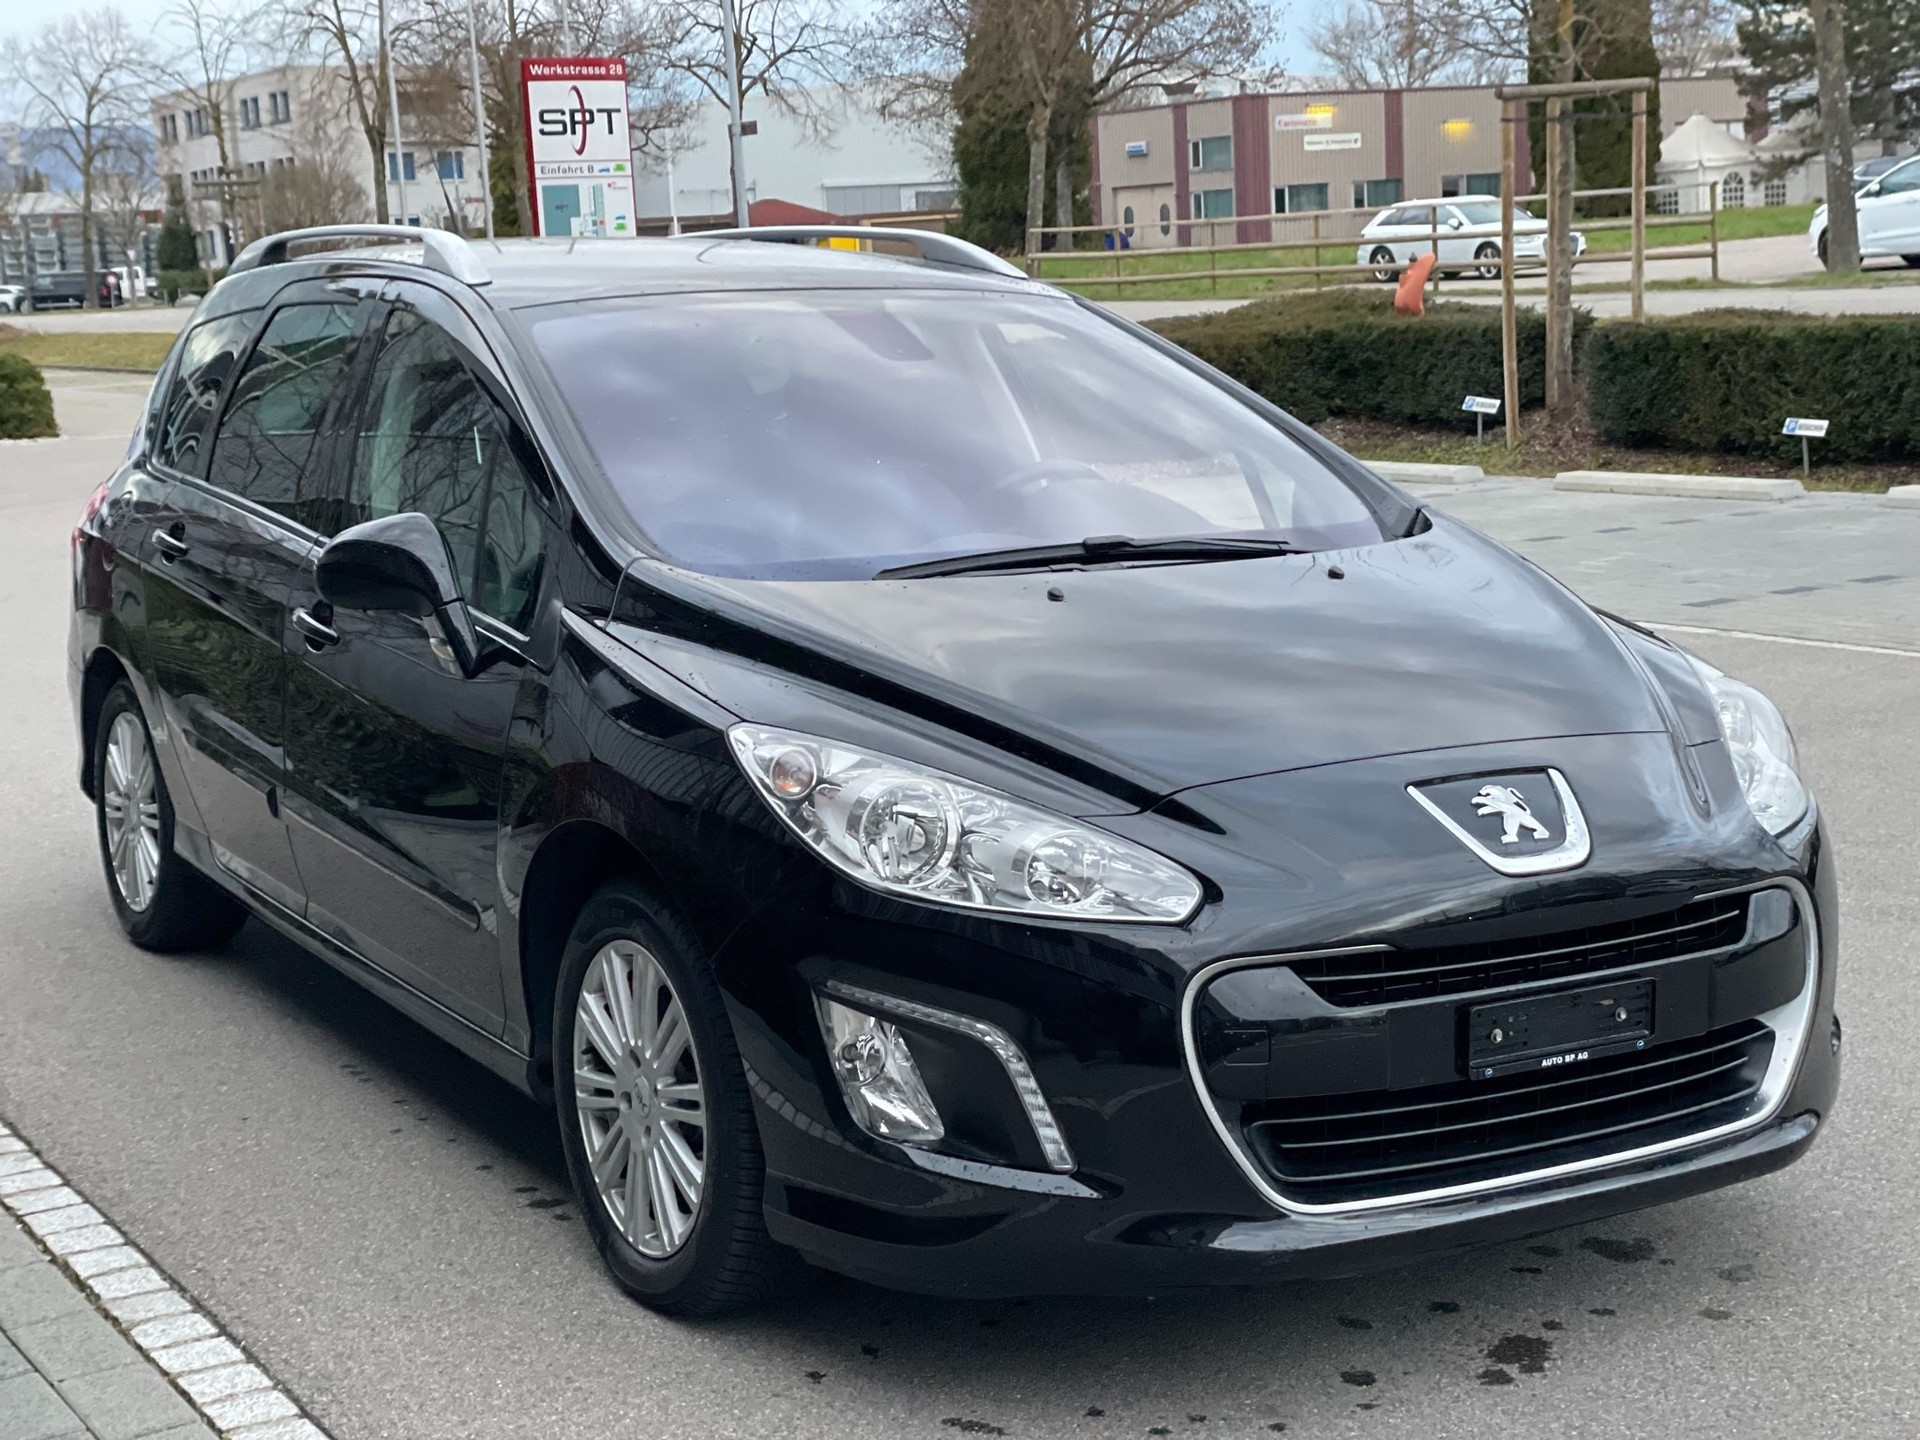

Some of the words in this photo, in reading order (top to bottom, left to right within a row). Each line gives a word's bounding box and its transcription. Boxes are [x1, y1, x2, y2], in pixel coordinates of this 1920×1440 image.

[529, 64, 606, 76] Werkstrasse
[609, 63, 623, 75] 28
[538, 108, 621, 136] SPT
[540, 165, 584, 175] Einfahrt
[587, 164, 594, 174] B
[1541, 1056, 1563, 1067] AUTO
[1564, 1054, 1575, 1062] BP
[1577, 1051, 1588, 1060] AG
